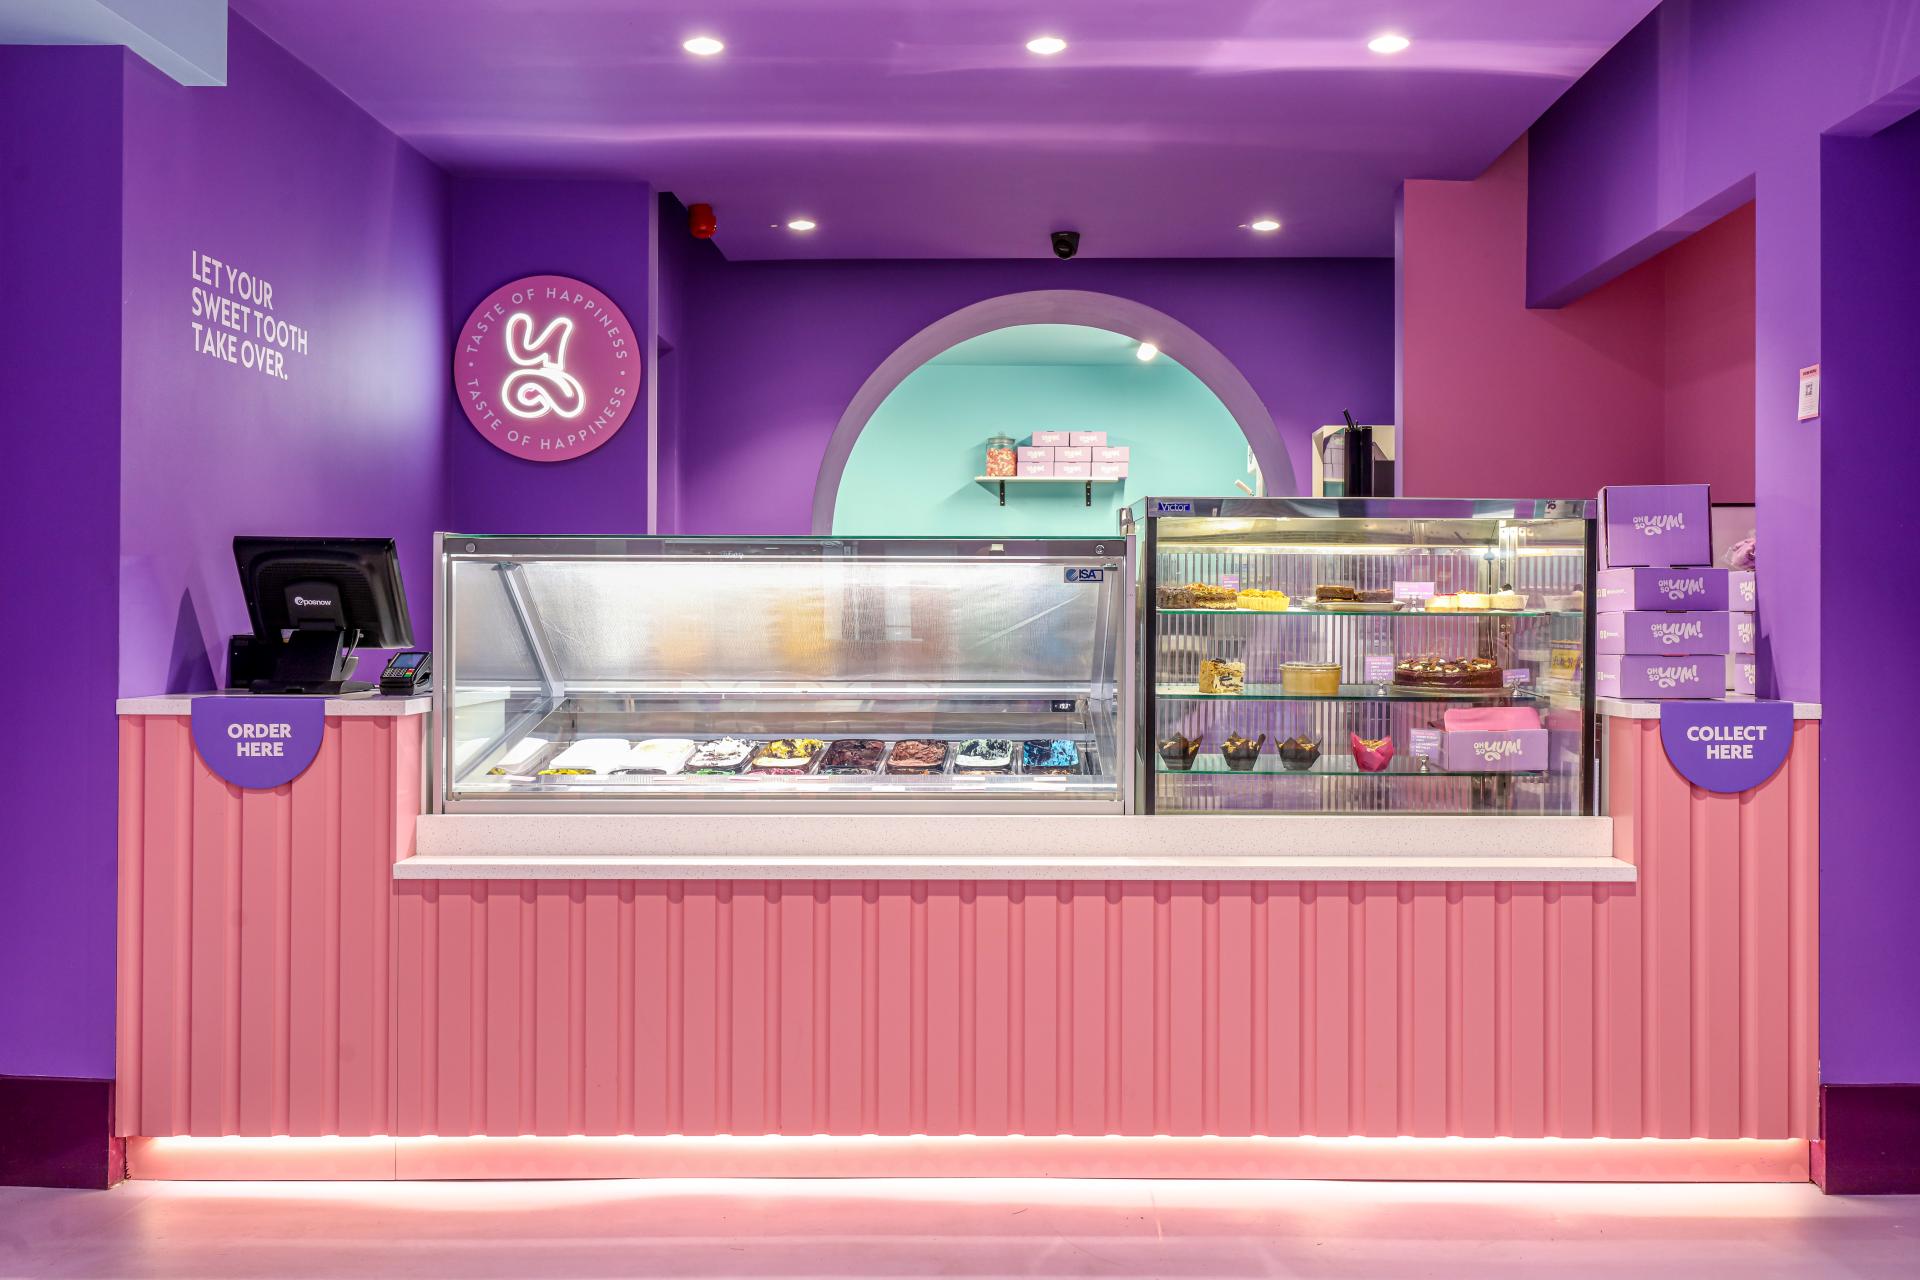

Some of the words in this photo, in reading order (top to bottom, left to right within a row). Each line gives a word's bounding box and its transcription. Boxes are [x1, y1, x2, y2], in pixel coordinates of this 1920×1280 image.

[192, 250, 222, 288] LET
[226, 265, 273, 310] YOUR
[192, 286, 251, 334] SWEET
[254, 310, 308, 356] TOOTH
[467, 303, 505, 353] TASTE
[511, 288, 536, 305] OF
[546, 287, 627, 360] HAPPINESS
[191, 321, 238, 364] TAKE
[241, 340, 288, 381] OVER.
[467, 378, 502, 431] TASTE
[507, 430, 531, 446] OF
[540, 387, 625, 450] HAPPINESS
[1160, 501, 1188, 512] Victor
[1635, 522, 1645, 530] SO
[1079, 569, 1096, 579] ISA
[1651, 623, 1662, 631] OH
[1647, 667, 1658, 675] OH
[1649, 674, 1660, 682] SO
[227, 723, 292, 739] ORDER
[1686, 726, 1768, 741] COLLECT
[236, 741, 284, 757] HERE
[1706, 744, 1754, 760] HERE
